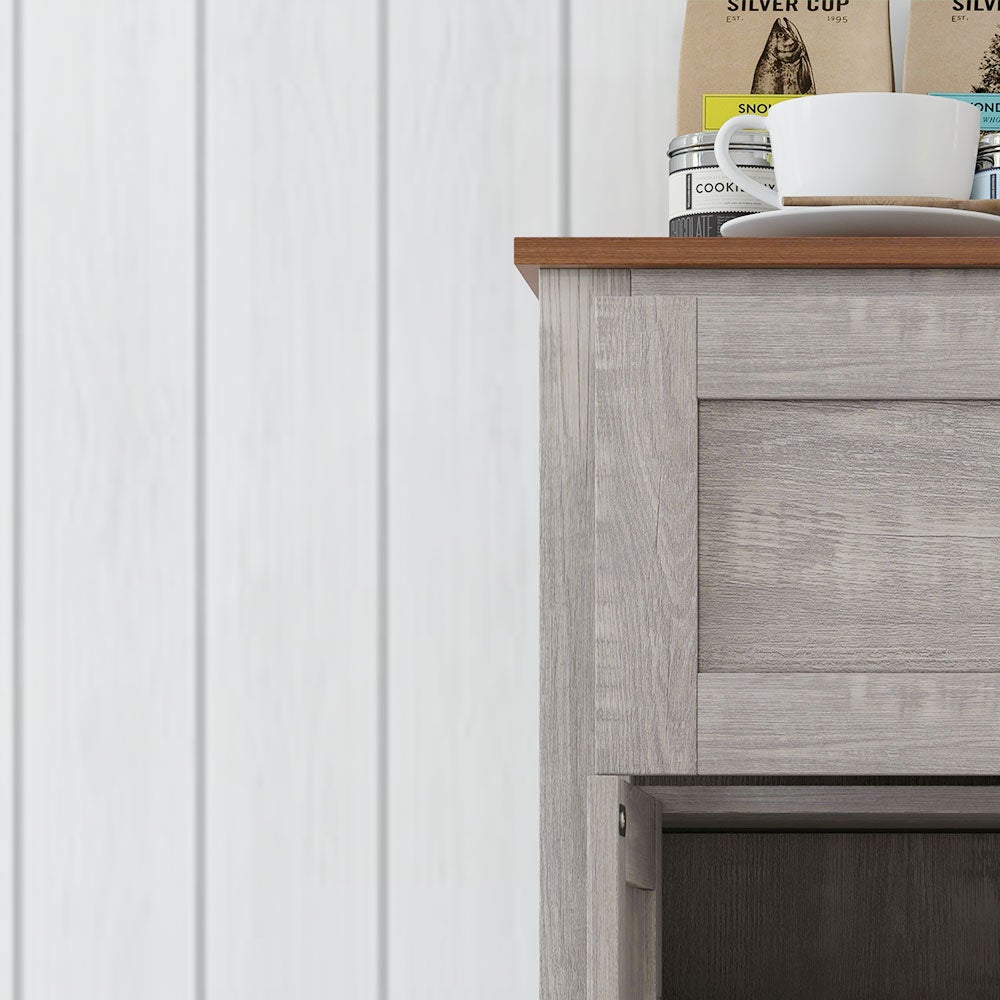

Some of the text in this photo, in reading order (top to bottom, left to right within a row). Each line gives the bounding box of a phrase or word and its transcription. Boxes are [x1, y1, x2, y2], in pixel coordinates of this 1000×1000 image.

[727, 0, 849, 11] SILVER CUP
[738, 103, 772, 114] SNO
[696, 182, 745, 194] COOKI
